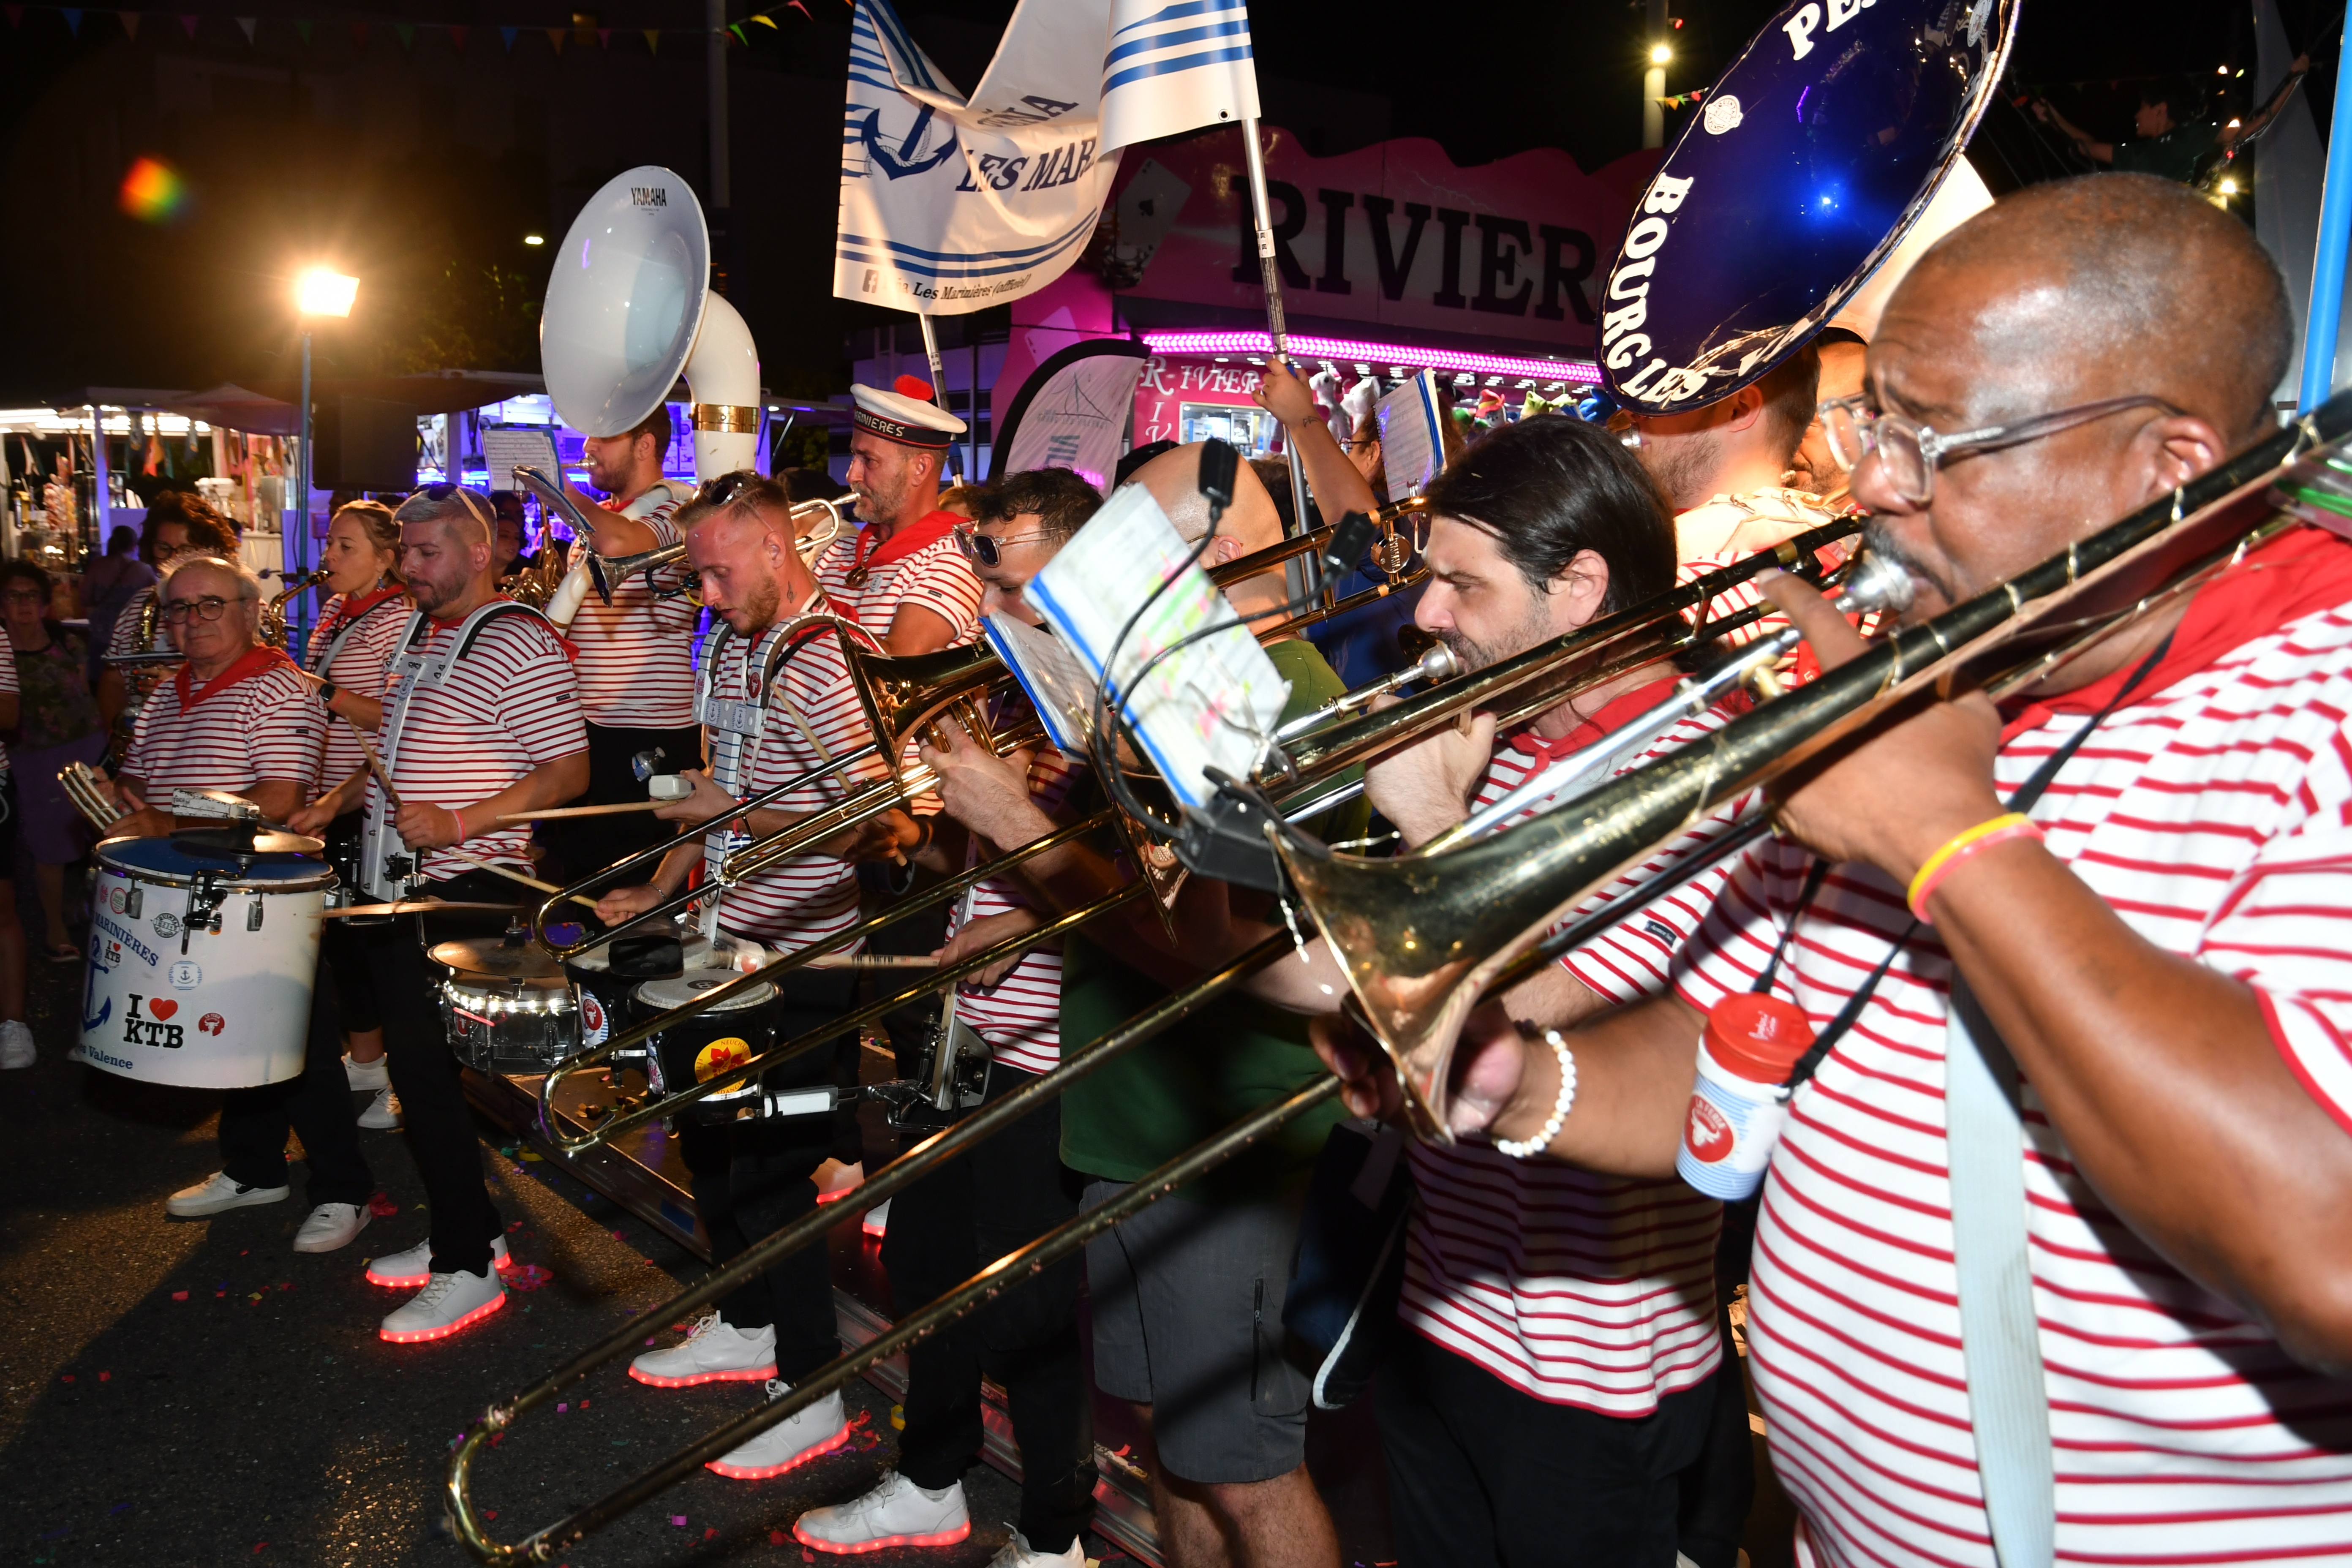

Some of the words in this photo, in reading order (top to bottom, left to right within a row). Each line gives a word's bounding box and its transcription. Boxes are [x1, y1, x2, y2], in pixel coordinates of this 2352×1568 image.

[1782, 0, 1876, 61] PE
[955, 150, 1030, 192] LES
[1021, 135, 1097, 192] MAR
[631, 188, 667, 207] YAMAHA
[1230, 174, 1600, 324] RIVIER
[1603, 172, 1693, 370] BOURG
[912, 282, 939, 299] Les
[940, 283, 993, 300] Marinières
[1620, 358, 1720, 403] LES
[104, 949, 121, 963] KTB
[107, 940, 112, 950] I
[127, 993, 143, 1019] I
[123, 1018, 184, 1049] KTB
[89, 1045, 133, 1069] Valence
